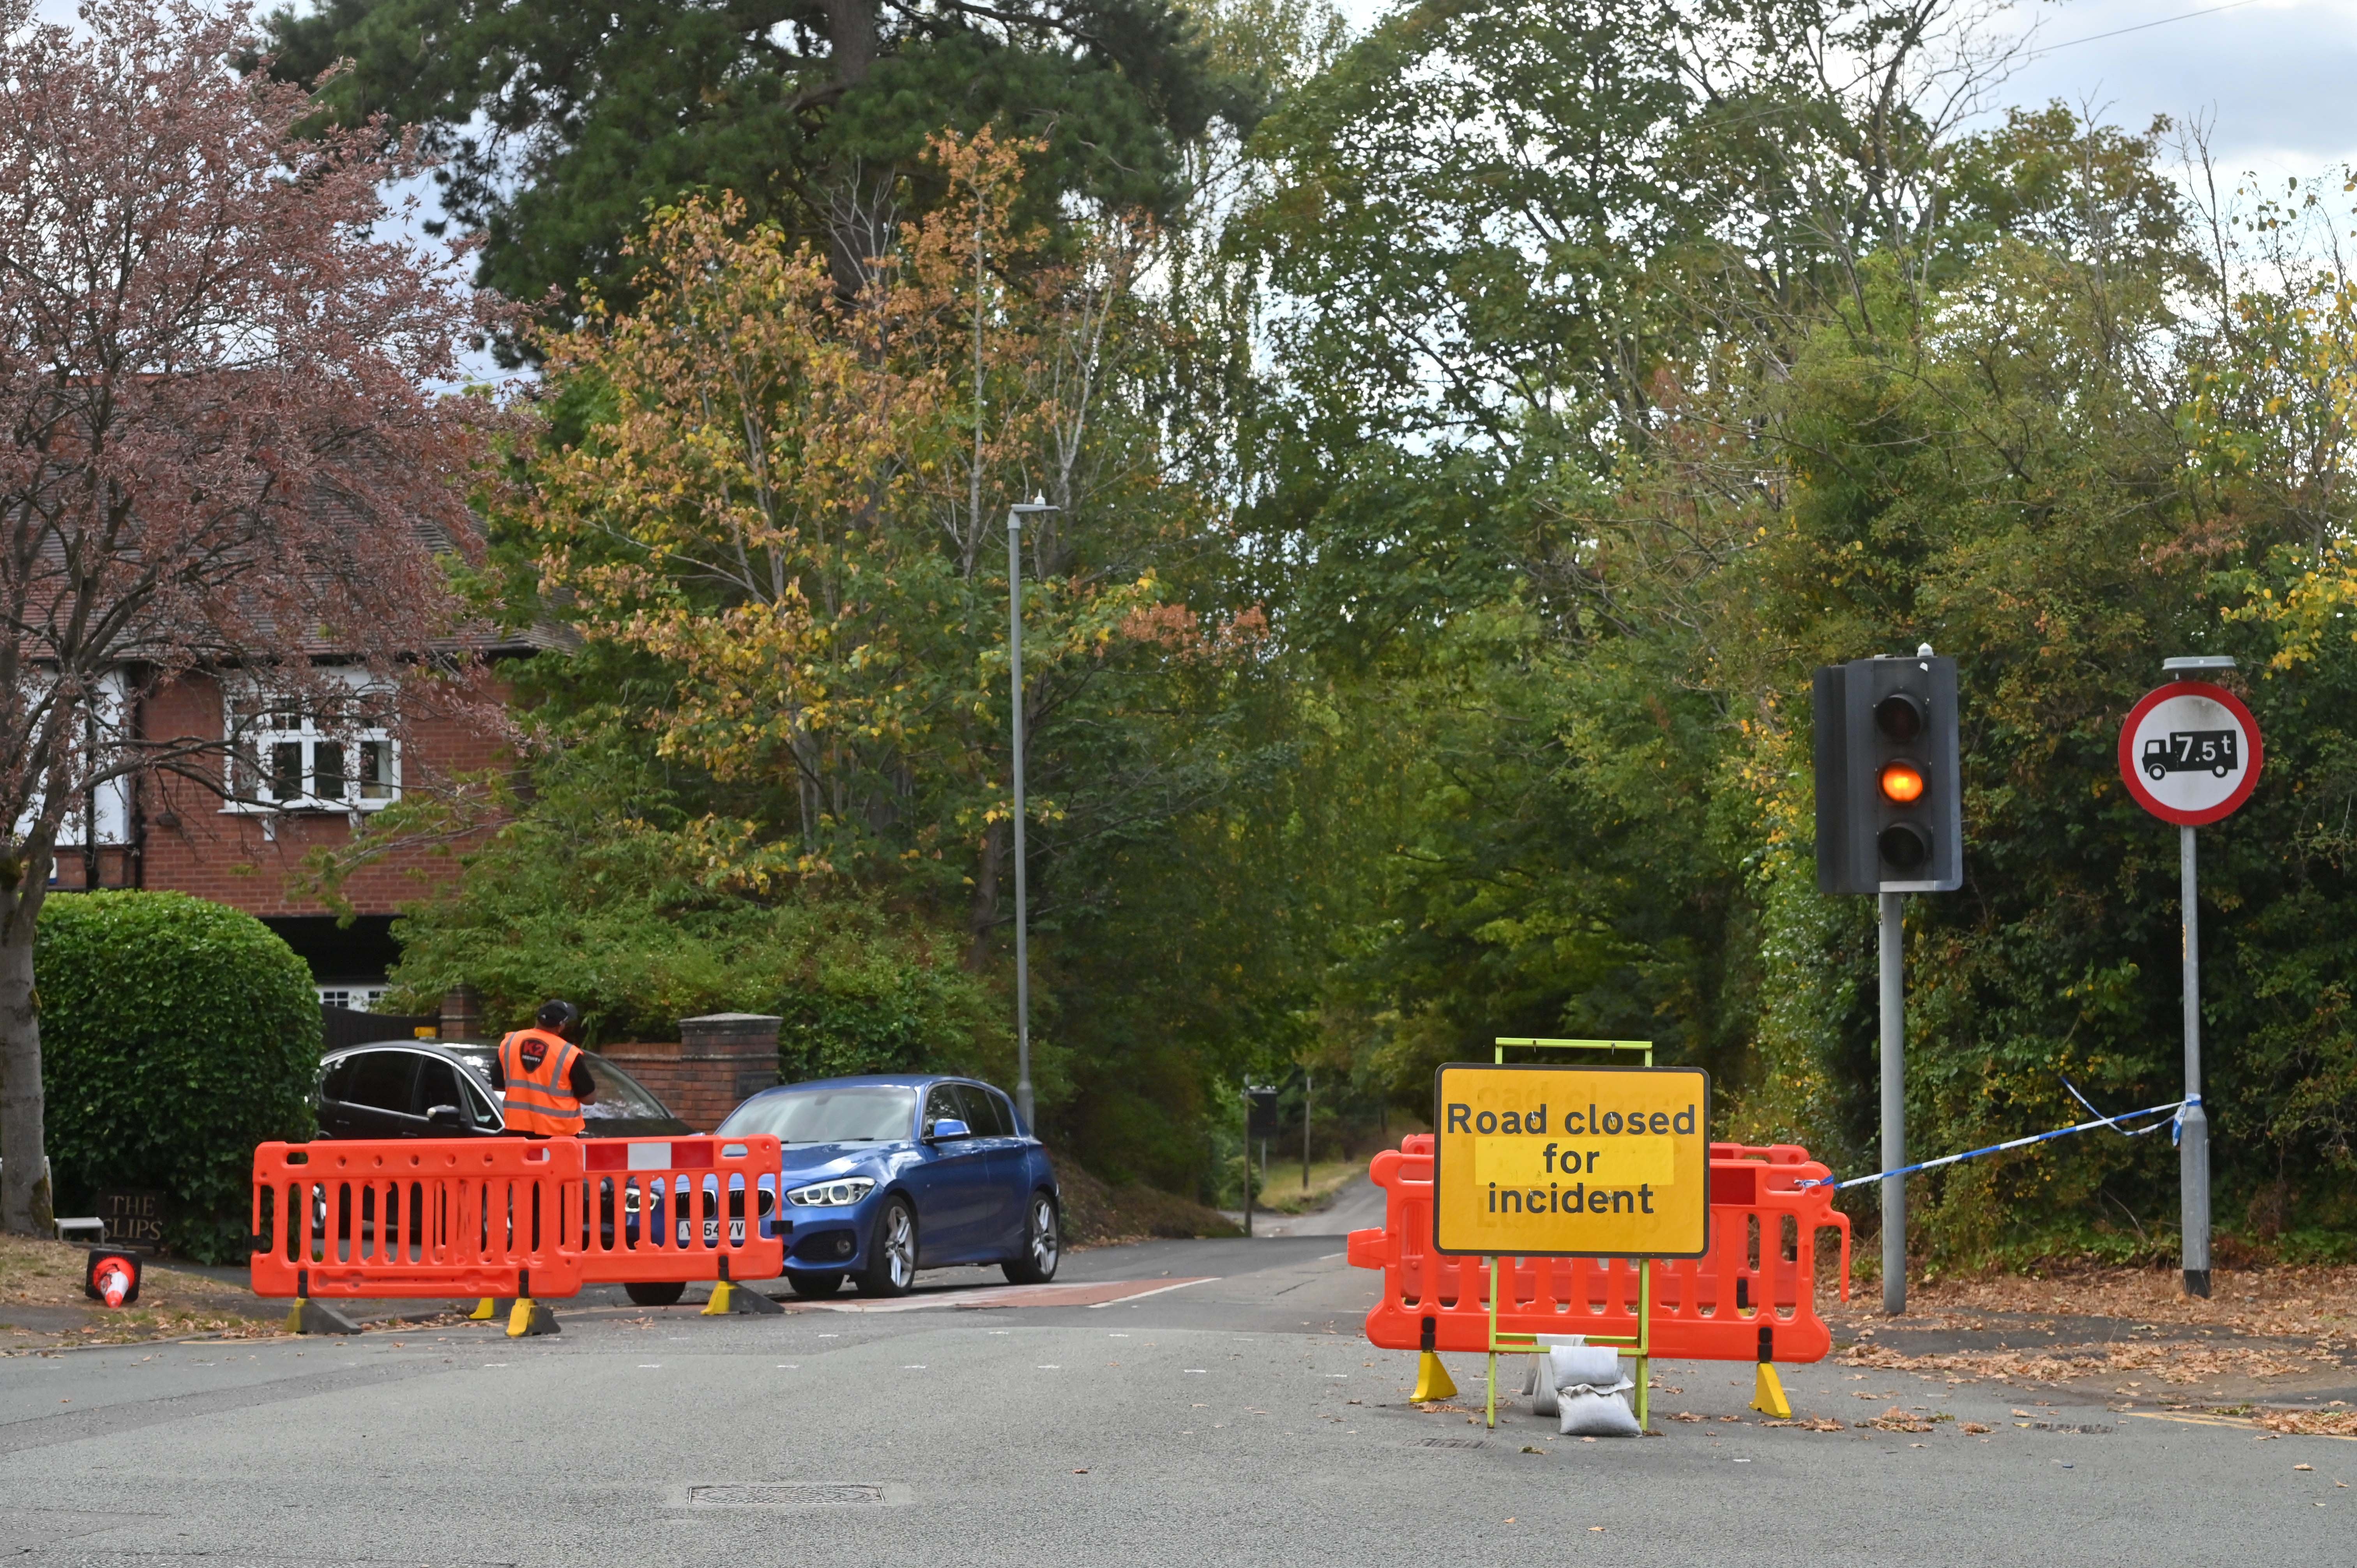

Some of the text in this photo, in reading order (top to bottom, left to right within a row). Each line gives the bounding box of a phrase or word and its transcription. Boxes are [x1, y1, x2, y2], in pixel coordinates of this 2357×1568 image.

[523, 1041, 544, 1056] K2
[1447, 1104, 1695, 1135] Road closed
[1543, 1143, 1600, 1174] for
[109, 1195, 156, 1216] THE
[1488, 1182, 1654, 1213] incident
